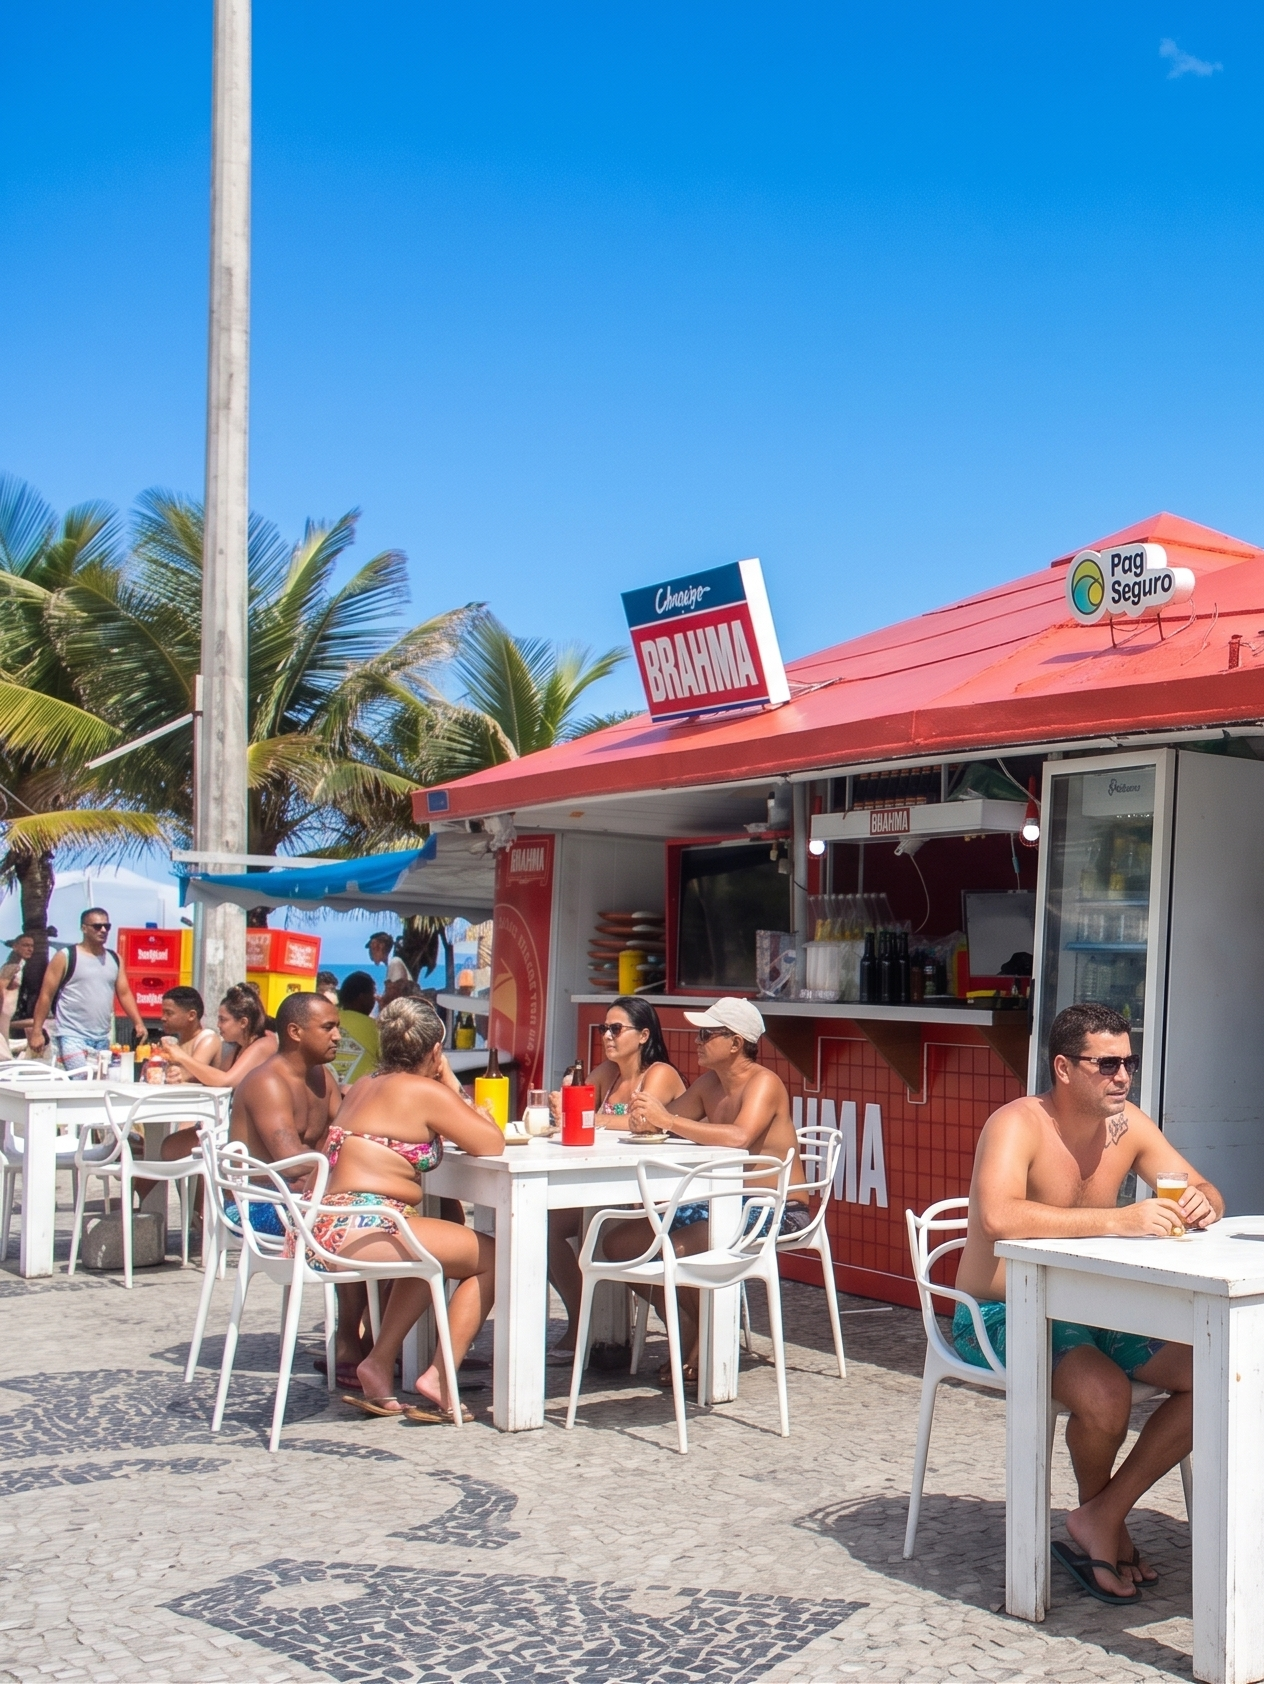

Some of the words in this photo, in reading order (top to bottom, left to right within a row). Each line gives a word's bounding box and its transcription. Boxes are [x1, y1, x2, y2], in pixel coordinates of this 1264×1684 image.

[1110, 551, 1144, 578] Pag
[1111, 573, 1172, 606] Seguro
[640, 619, 759, 703] BRAHMA
